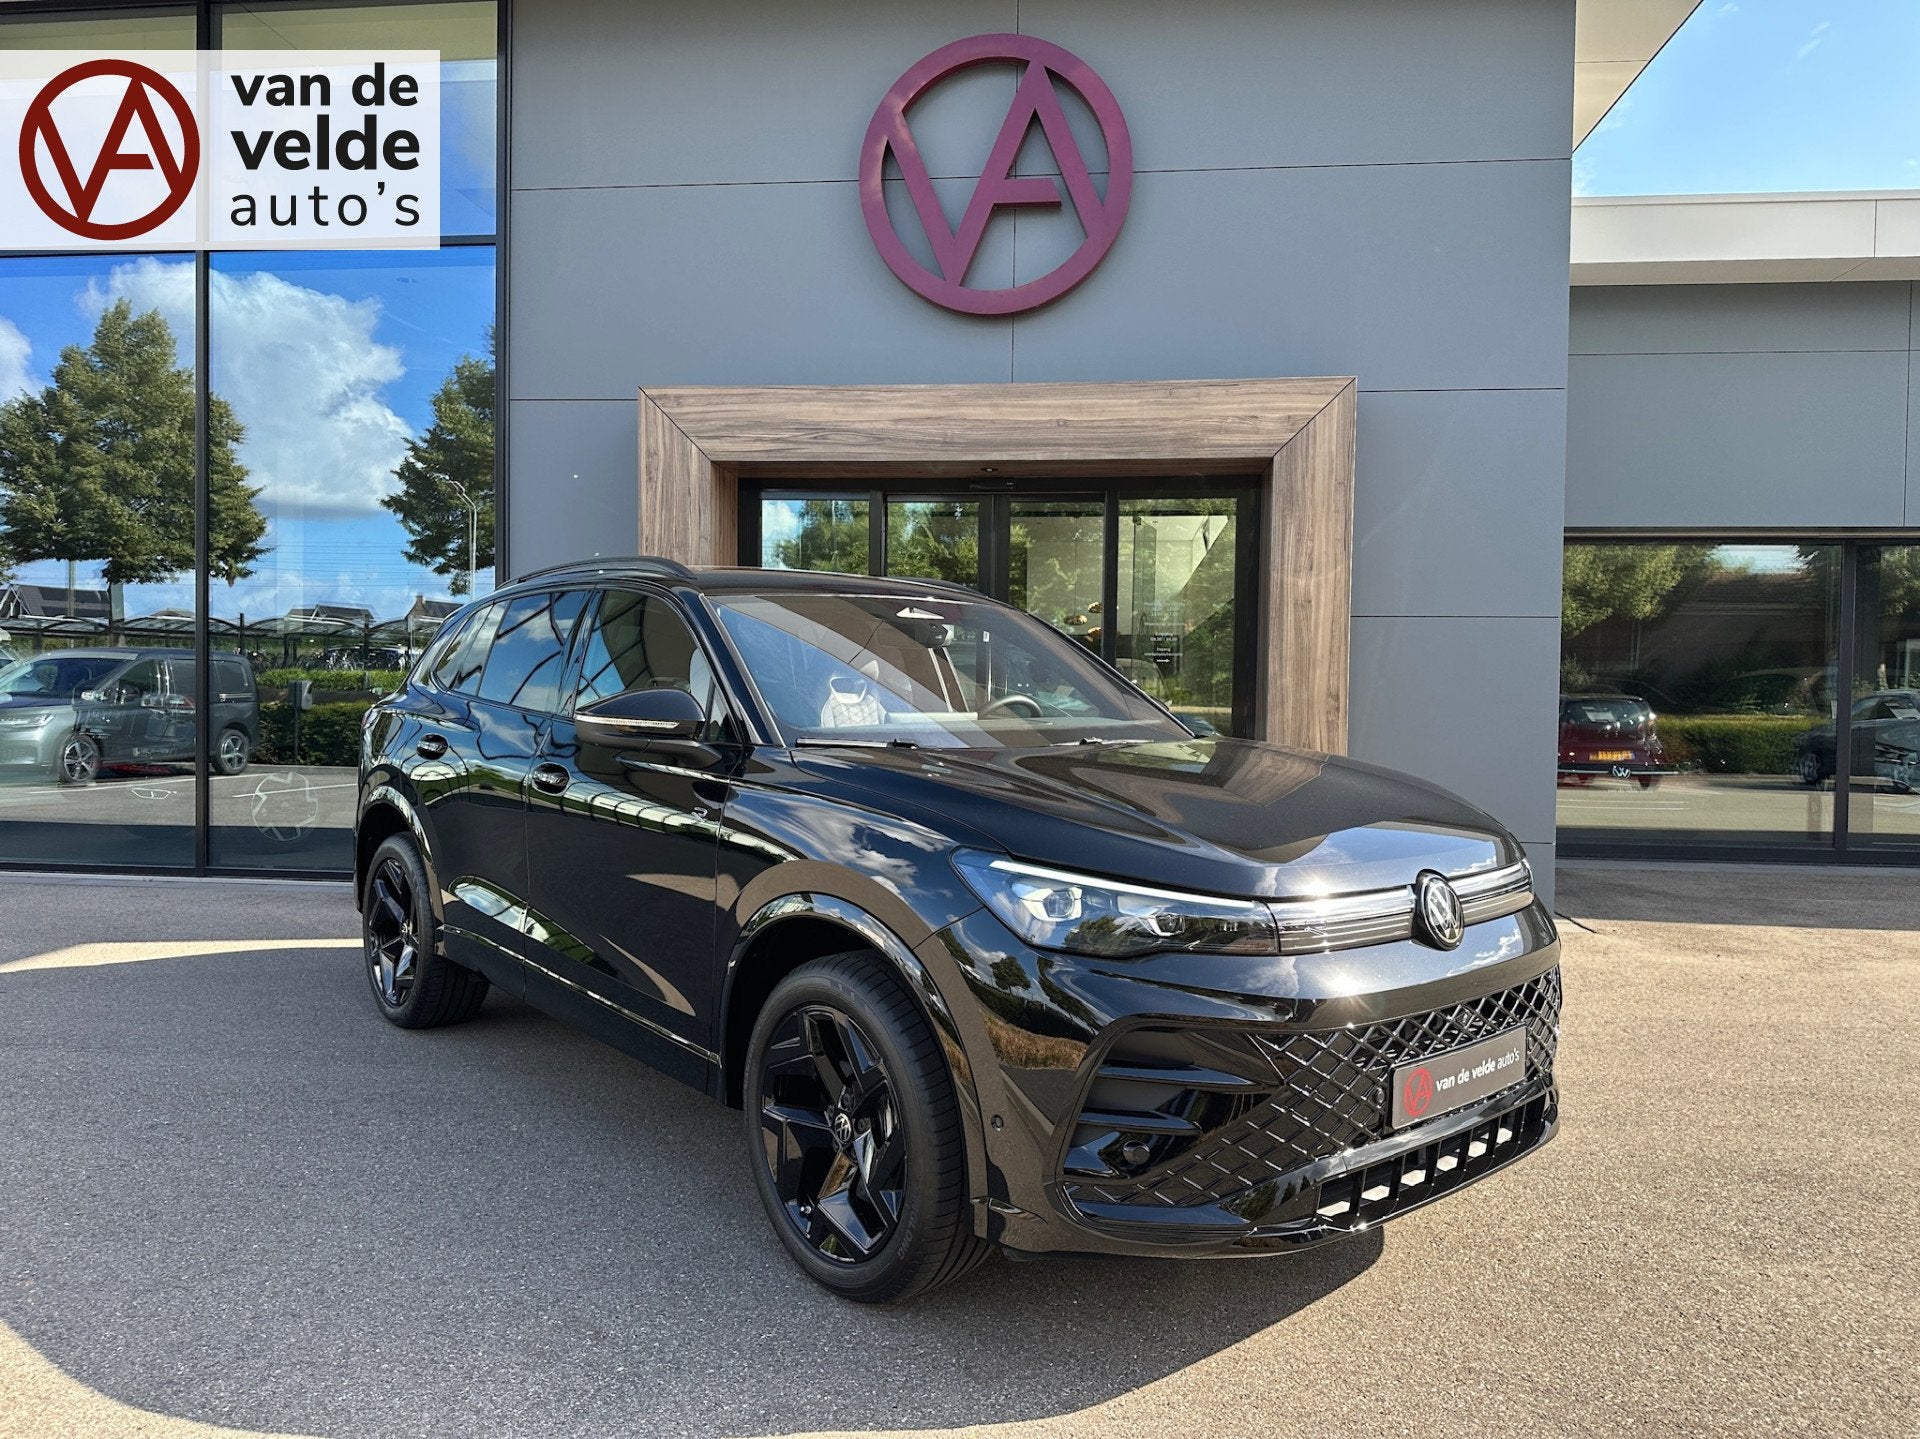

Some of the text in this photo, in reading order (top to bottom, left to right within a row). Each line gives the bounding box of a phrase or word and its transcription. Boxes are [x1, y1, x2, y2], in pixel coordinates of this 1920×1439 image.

[1435, 1047, 1520, 1092] van de velde auto's
